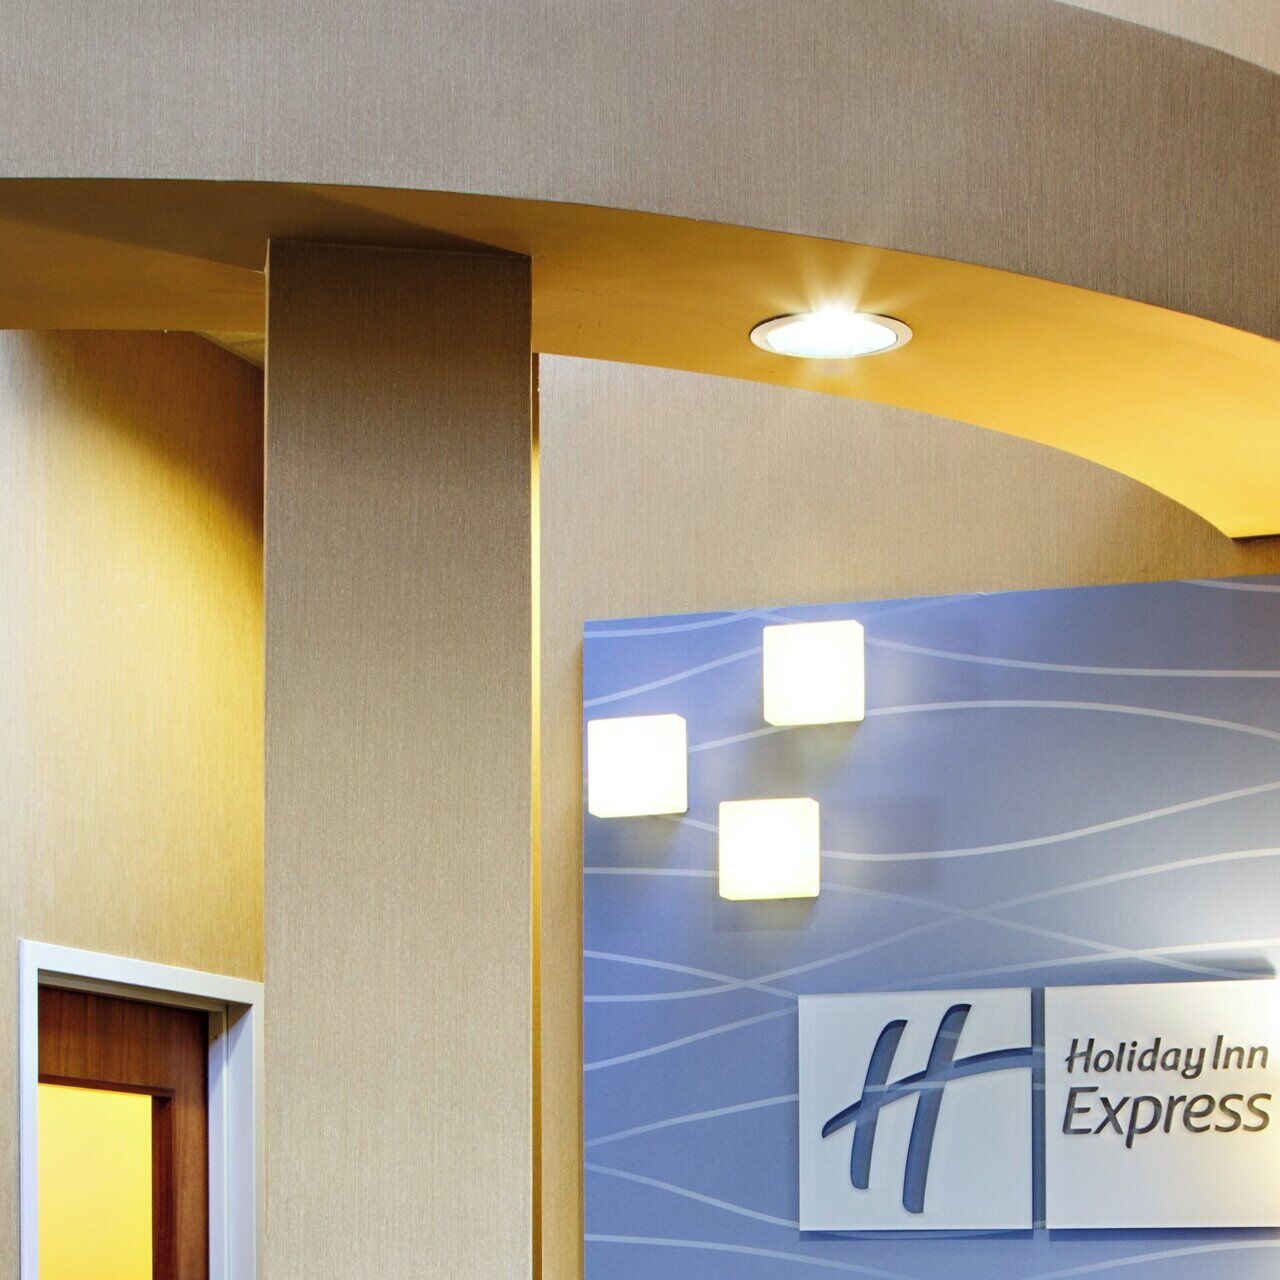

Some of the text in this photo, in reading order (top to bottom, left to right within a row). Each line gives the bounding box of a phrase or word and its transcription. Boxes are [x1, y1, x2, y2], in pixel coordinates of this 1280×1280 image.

[1065, 1034, 1270, 1079] Holiday Inn
[1061, 1086, 1273, 1149] Express
